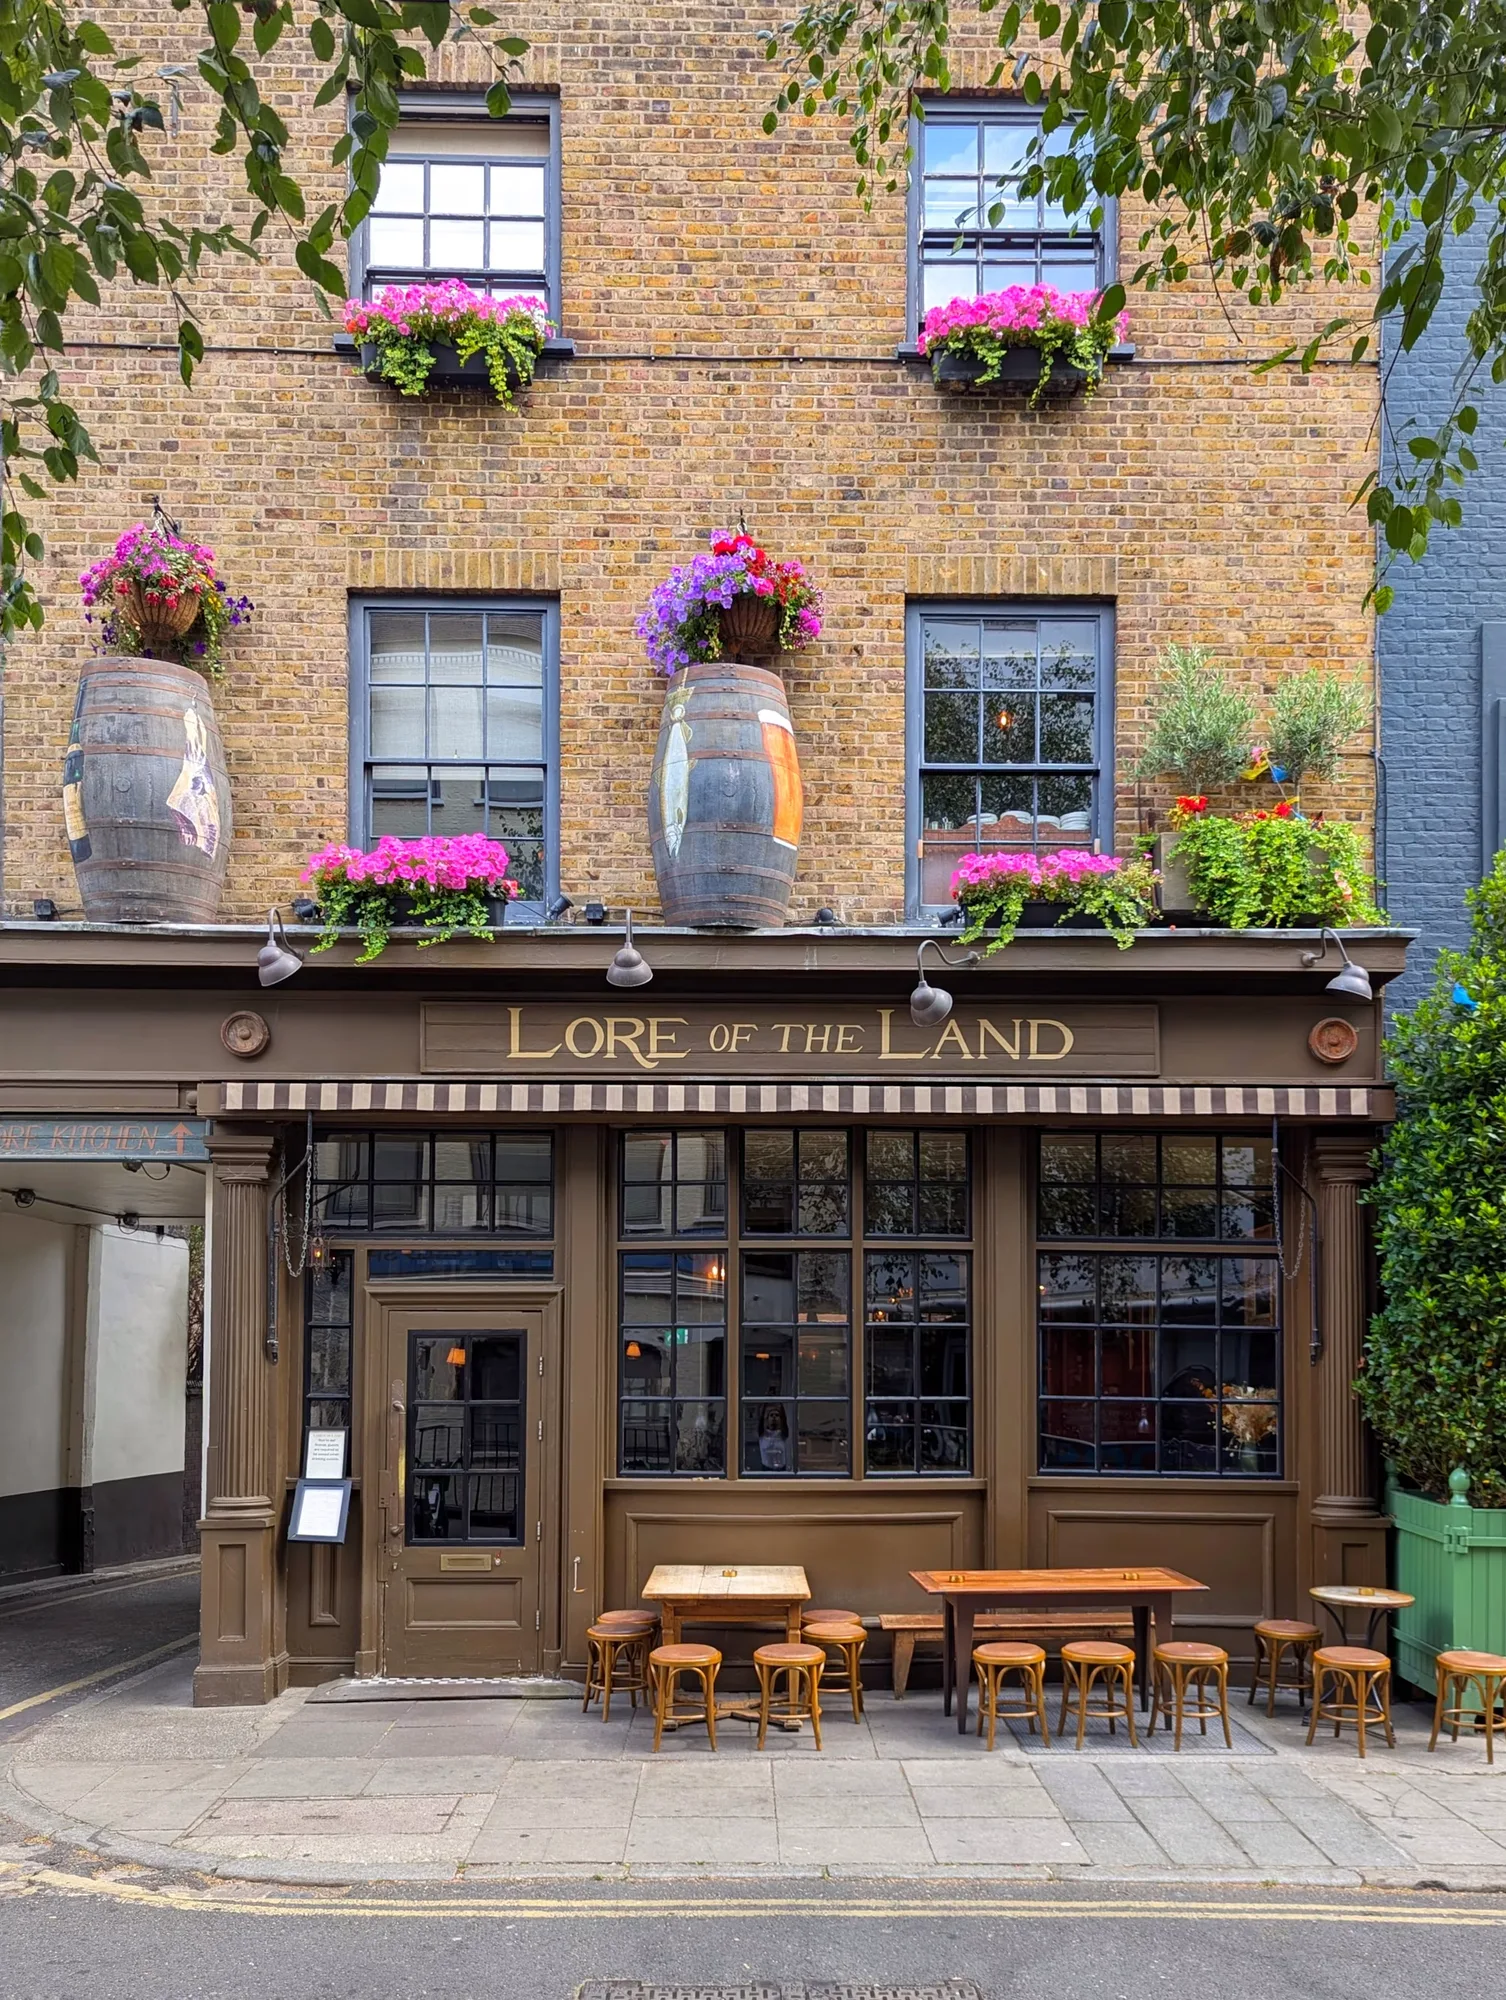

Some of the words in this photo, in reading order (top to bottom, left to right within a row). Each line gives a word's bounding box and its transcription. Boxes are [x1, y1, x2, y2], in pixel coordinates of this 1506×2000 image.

[507, 1007, 692, 1070] LORE
[708, 1023, 759, 1053] OF
[770, 1023, 866, 1053] THE
[876, 1008, 1075, 1061] LAND
[50, 1124, 159, 1151] KITCHEN
